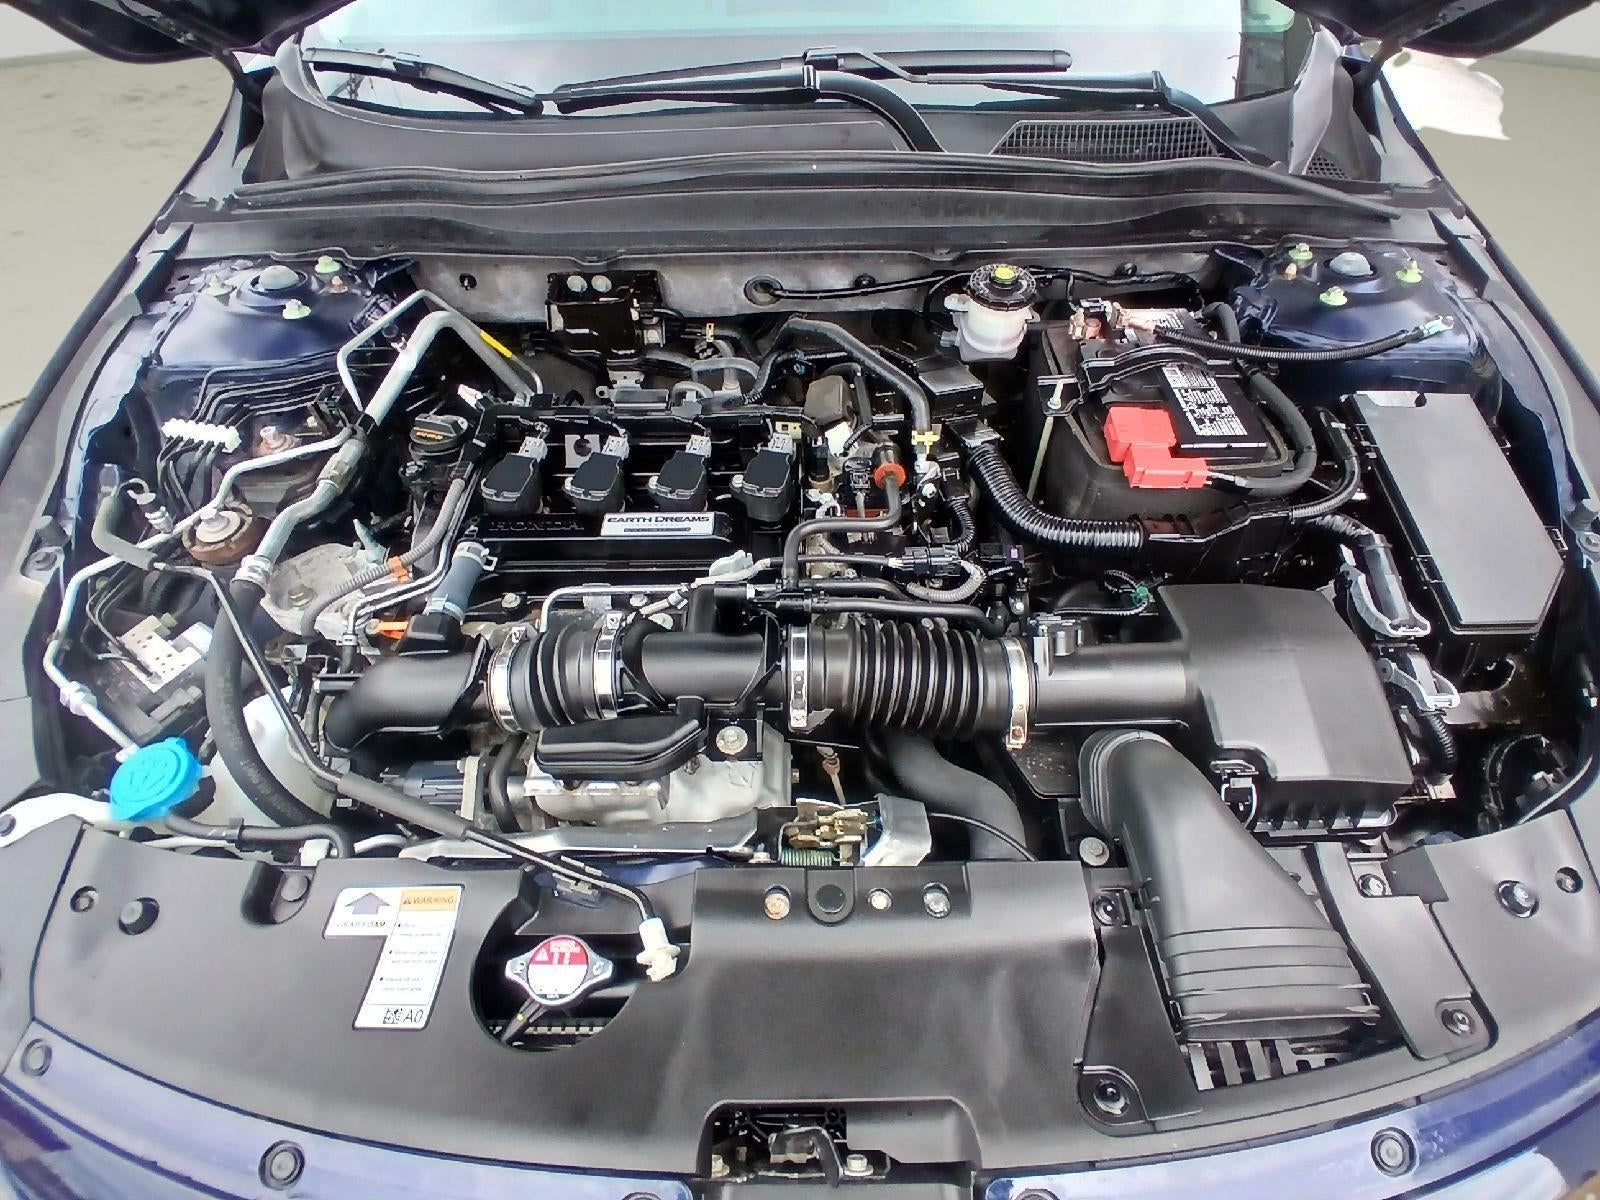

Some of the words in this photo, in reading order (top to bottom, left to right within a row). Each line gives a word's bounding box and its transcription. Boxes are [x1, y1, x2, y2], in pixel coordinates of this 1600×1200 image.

[654, 515, 710, 523] DREAMS
[488, 521, 585, 531] HONDA
[413, 896, 454, 904] WARNING
